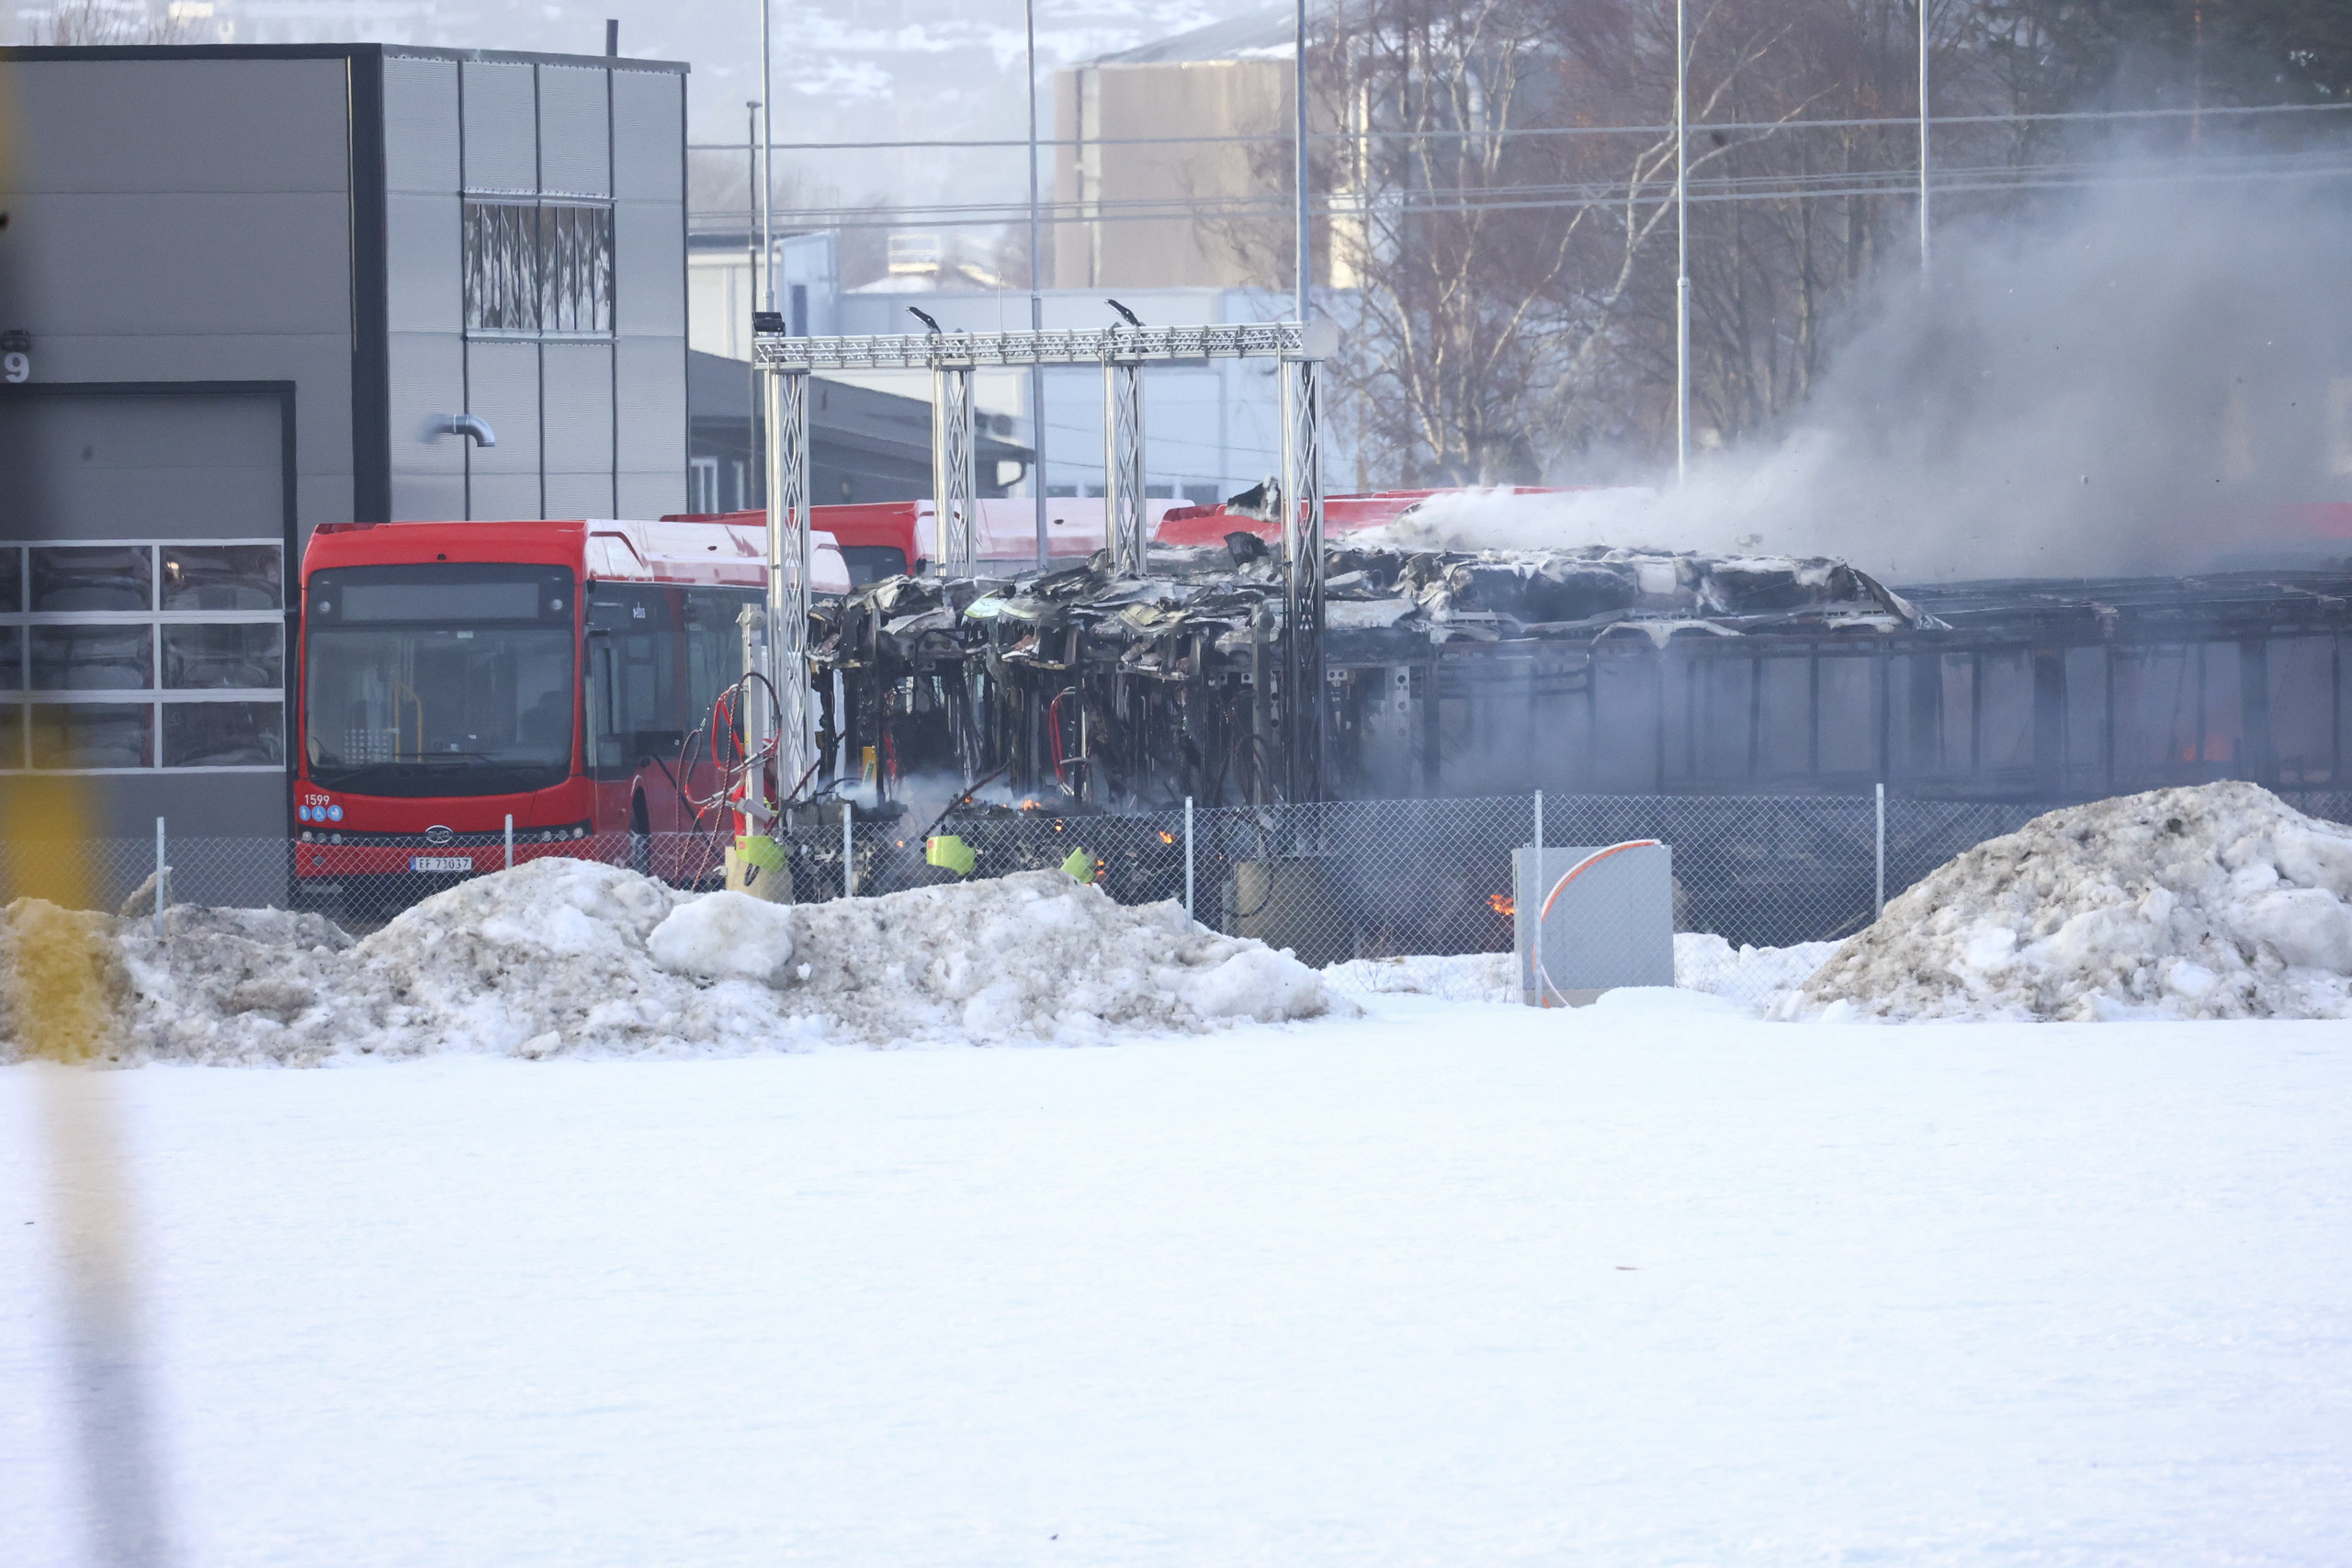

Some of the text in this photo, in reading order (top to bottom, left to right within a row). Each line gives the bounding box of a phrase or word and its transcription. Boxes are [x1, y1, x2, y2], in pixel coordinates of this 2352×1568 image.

[4, 352, 29, 383] 9
[304, 794, 330, 806] 1599
[435, 858, 469, 869] 73037
